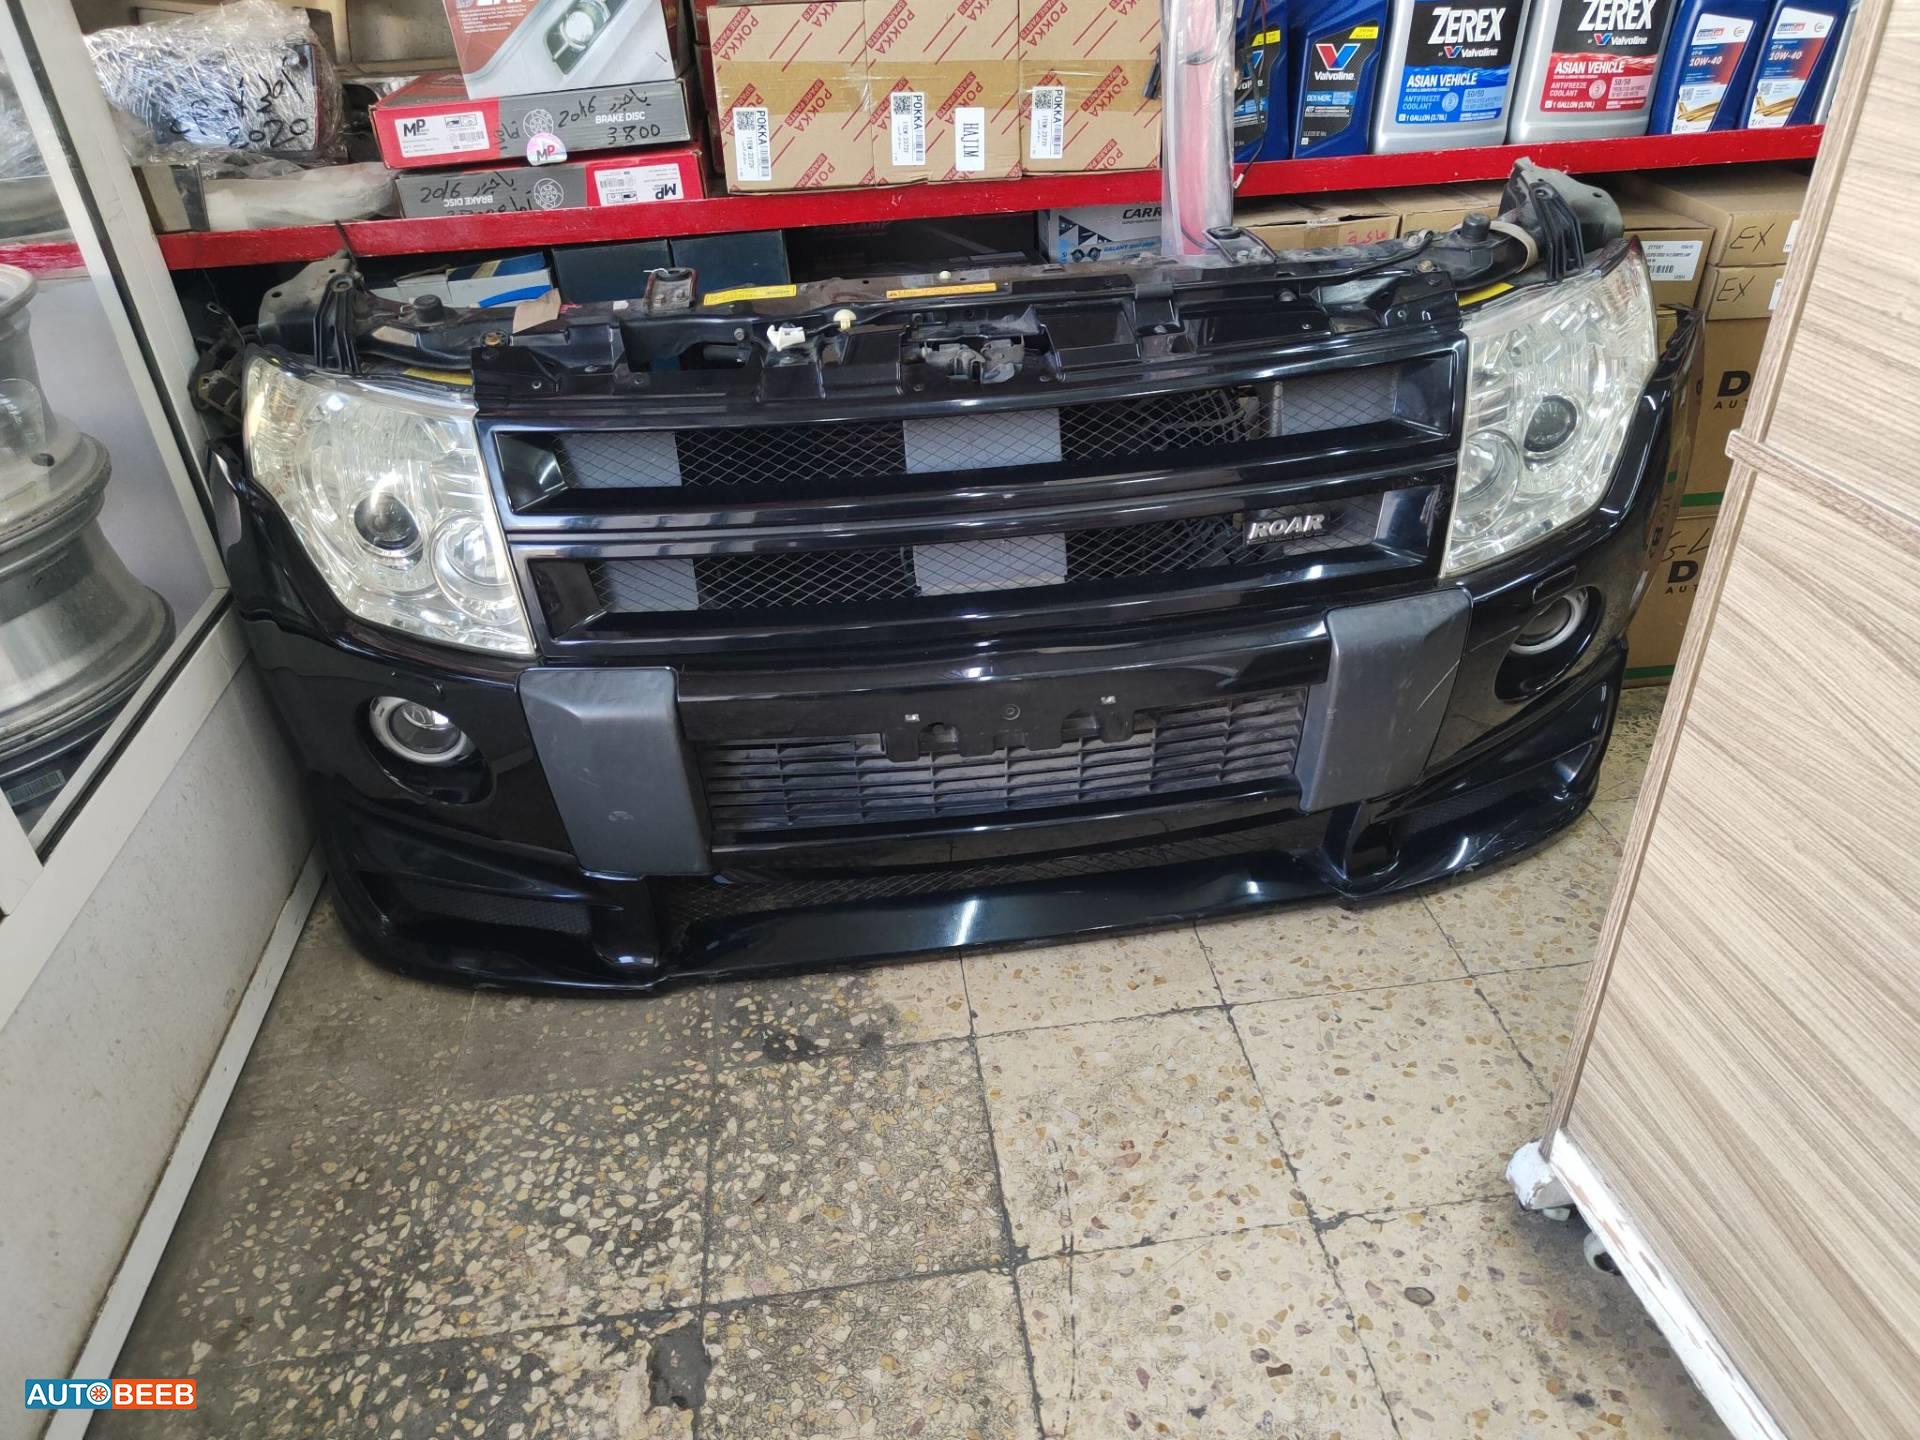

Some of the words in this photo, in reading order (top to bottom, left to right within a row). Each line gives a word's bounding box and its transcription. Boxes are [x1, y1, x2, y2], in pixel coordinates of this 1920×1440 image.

[1027, 1, 1068, 47] POKKA
[1428, 7, 1506, 44] ZEREX
[1577, 0, 1657, 31] ZEREX
[720, 14, 759, 61] POKKA
[875, 8, 915, 54] POKKA
[1611, 36, 1647, 45] Valvoline
[1461, 47, 1498, 57] Valvoline
[1689, 56, 1722, 67] 10W-40
[1769, 51, 1802, 60] 10W-40
[1314, 72, 1355, 81] Valvoline
[1554, 61, 1586, 74] ASIAN
[1588, 60, 1625, 73] VEHICLE
[1407, 74, 1437, 88] ASIAN
[1440, 72, 1478, 87] VEHICLE
[1053, 90, 1062, 123] POKKA
[1089, 75, 1129, 117] POKKA
[595, 113, 624, 124] BRAKE
[626, 111, 645, 121] DISC
[795, 88, 832, 132] POKKA
[913, 95, 922, 129] POKKA
[404, 119, 425, 137] MP
[608, 124, 660, 145] 3800
[757, 110, 767, 145] POKKA
[961, 123, 979, 158] HAJIM
[537, 145, 555, 162] MP
[444, 198, 463, 208] DISC
[464, 195, 494, 205] BRAKE
[655, 183, 677, 200] MP
[1122, 207, 1162, 219] CARR
[1730, 223, 1775, 253] EX
[1717, 275, 1756, 303] EX
[1717, 370, 1750, 397] D
[1248, 514, 1325, 540] ROAR
[1667, 560, 1698, 584] D
